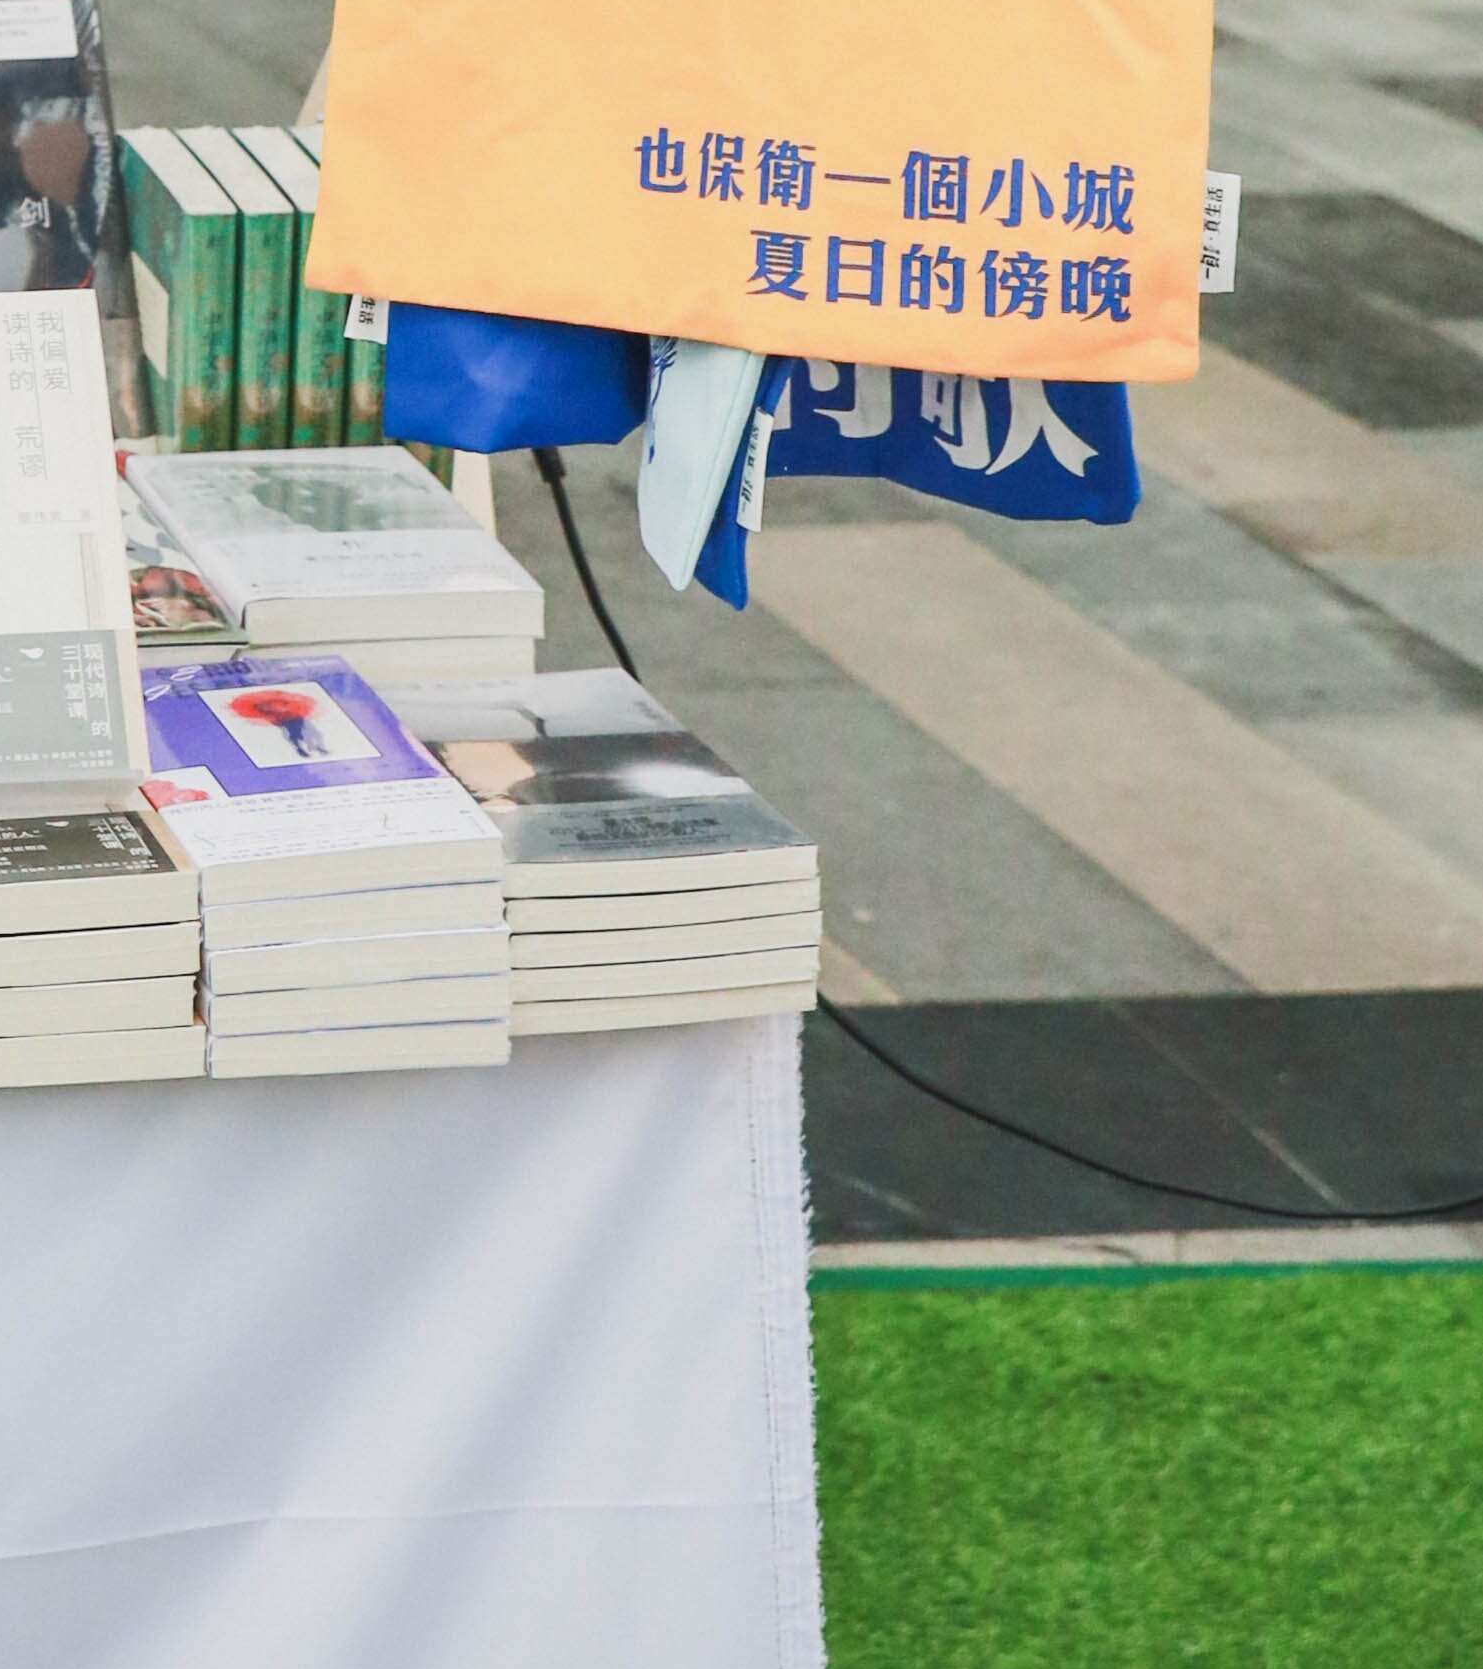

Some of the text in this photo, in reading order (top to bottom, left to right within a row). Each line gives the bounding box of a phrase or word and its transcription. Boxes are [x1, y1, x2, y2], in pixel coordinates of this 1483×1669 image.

[633, 126, 1137, 235] 也保衛一個小城
[746, 229, 1133, 323] 夏日的傍晚
